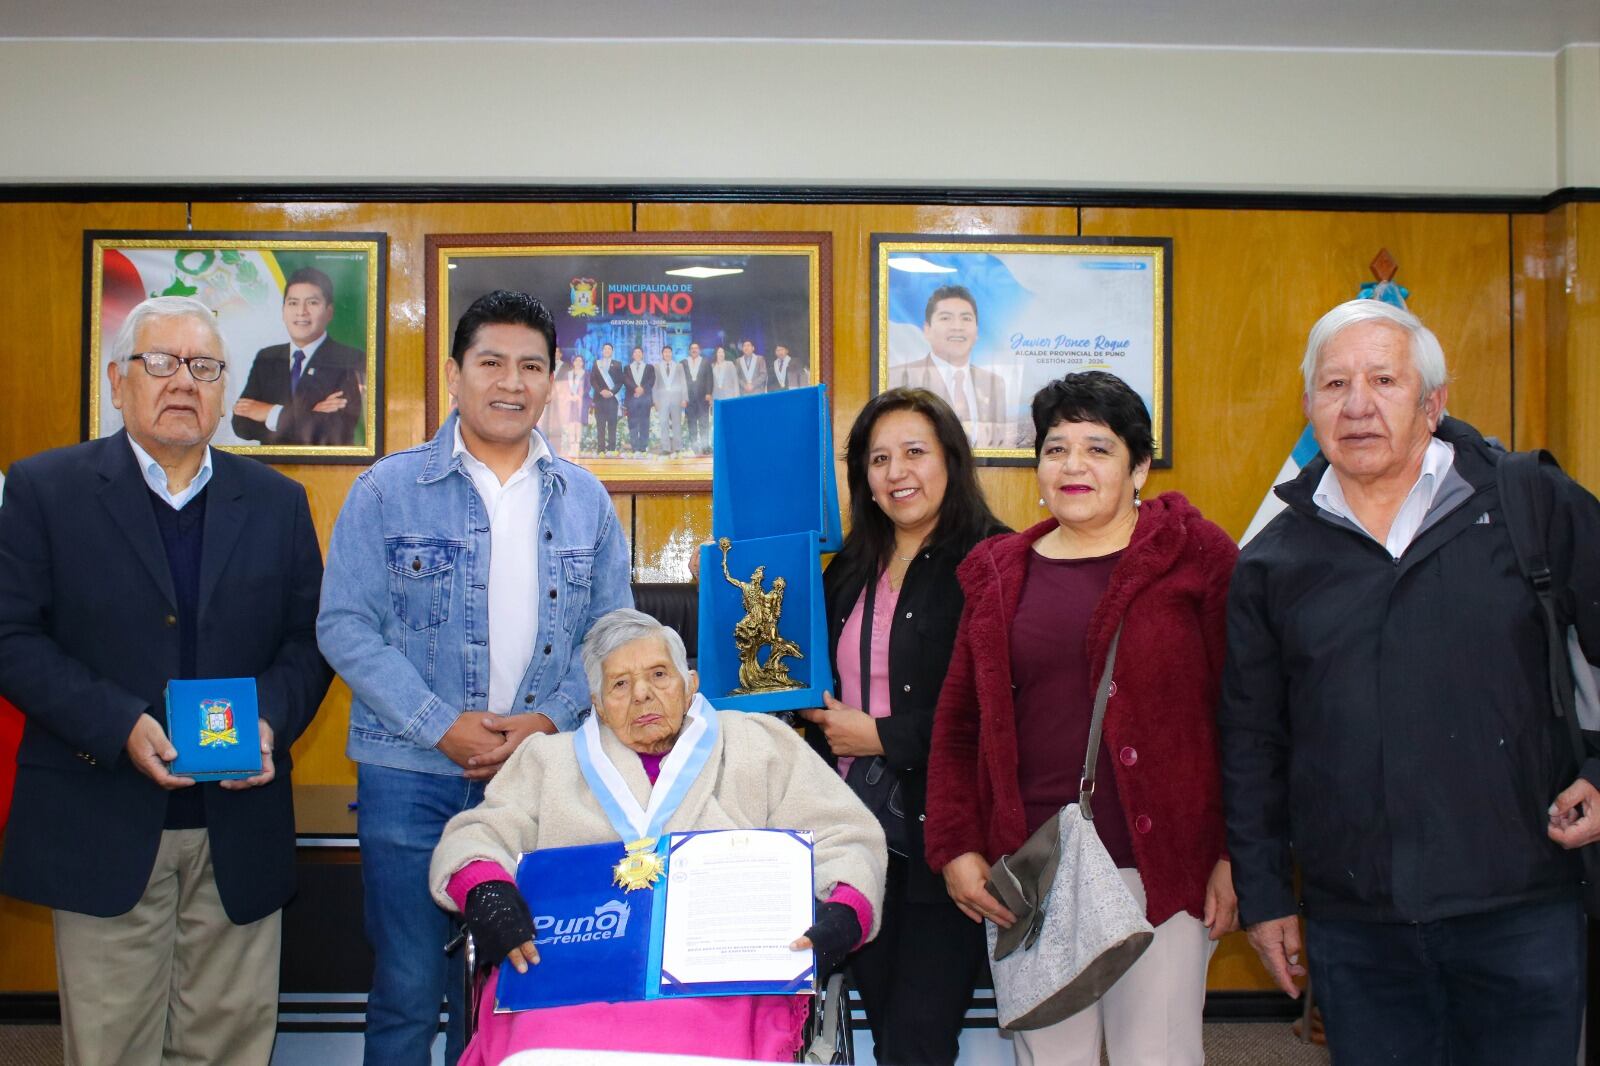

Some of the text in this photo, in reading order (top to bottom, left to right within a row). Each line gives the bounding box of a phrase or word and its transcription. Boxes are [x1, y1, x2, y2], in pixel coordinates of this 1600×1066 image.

[608, 284, 693, 292] MUNICIPALIDAD DE
[607, 292, 693, 315] PUNO
[1010, 333, 1130, 351] Javier Ponce Roque
[533, 914, 618, 935] Puno
[553, 931, 612, 944] renace
